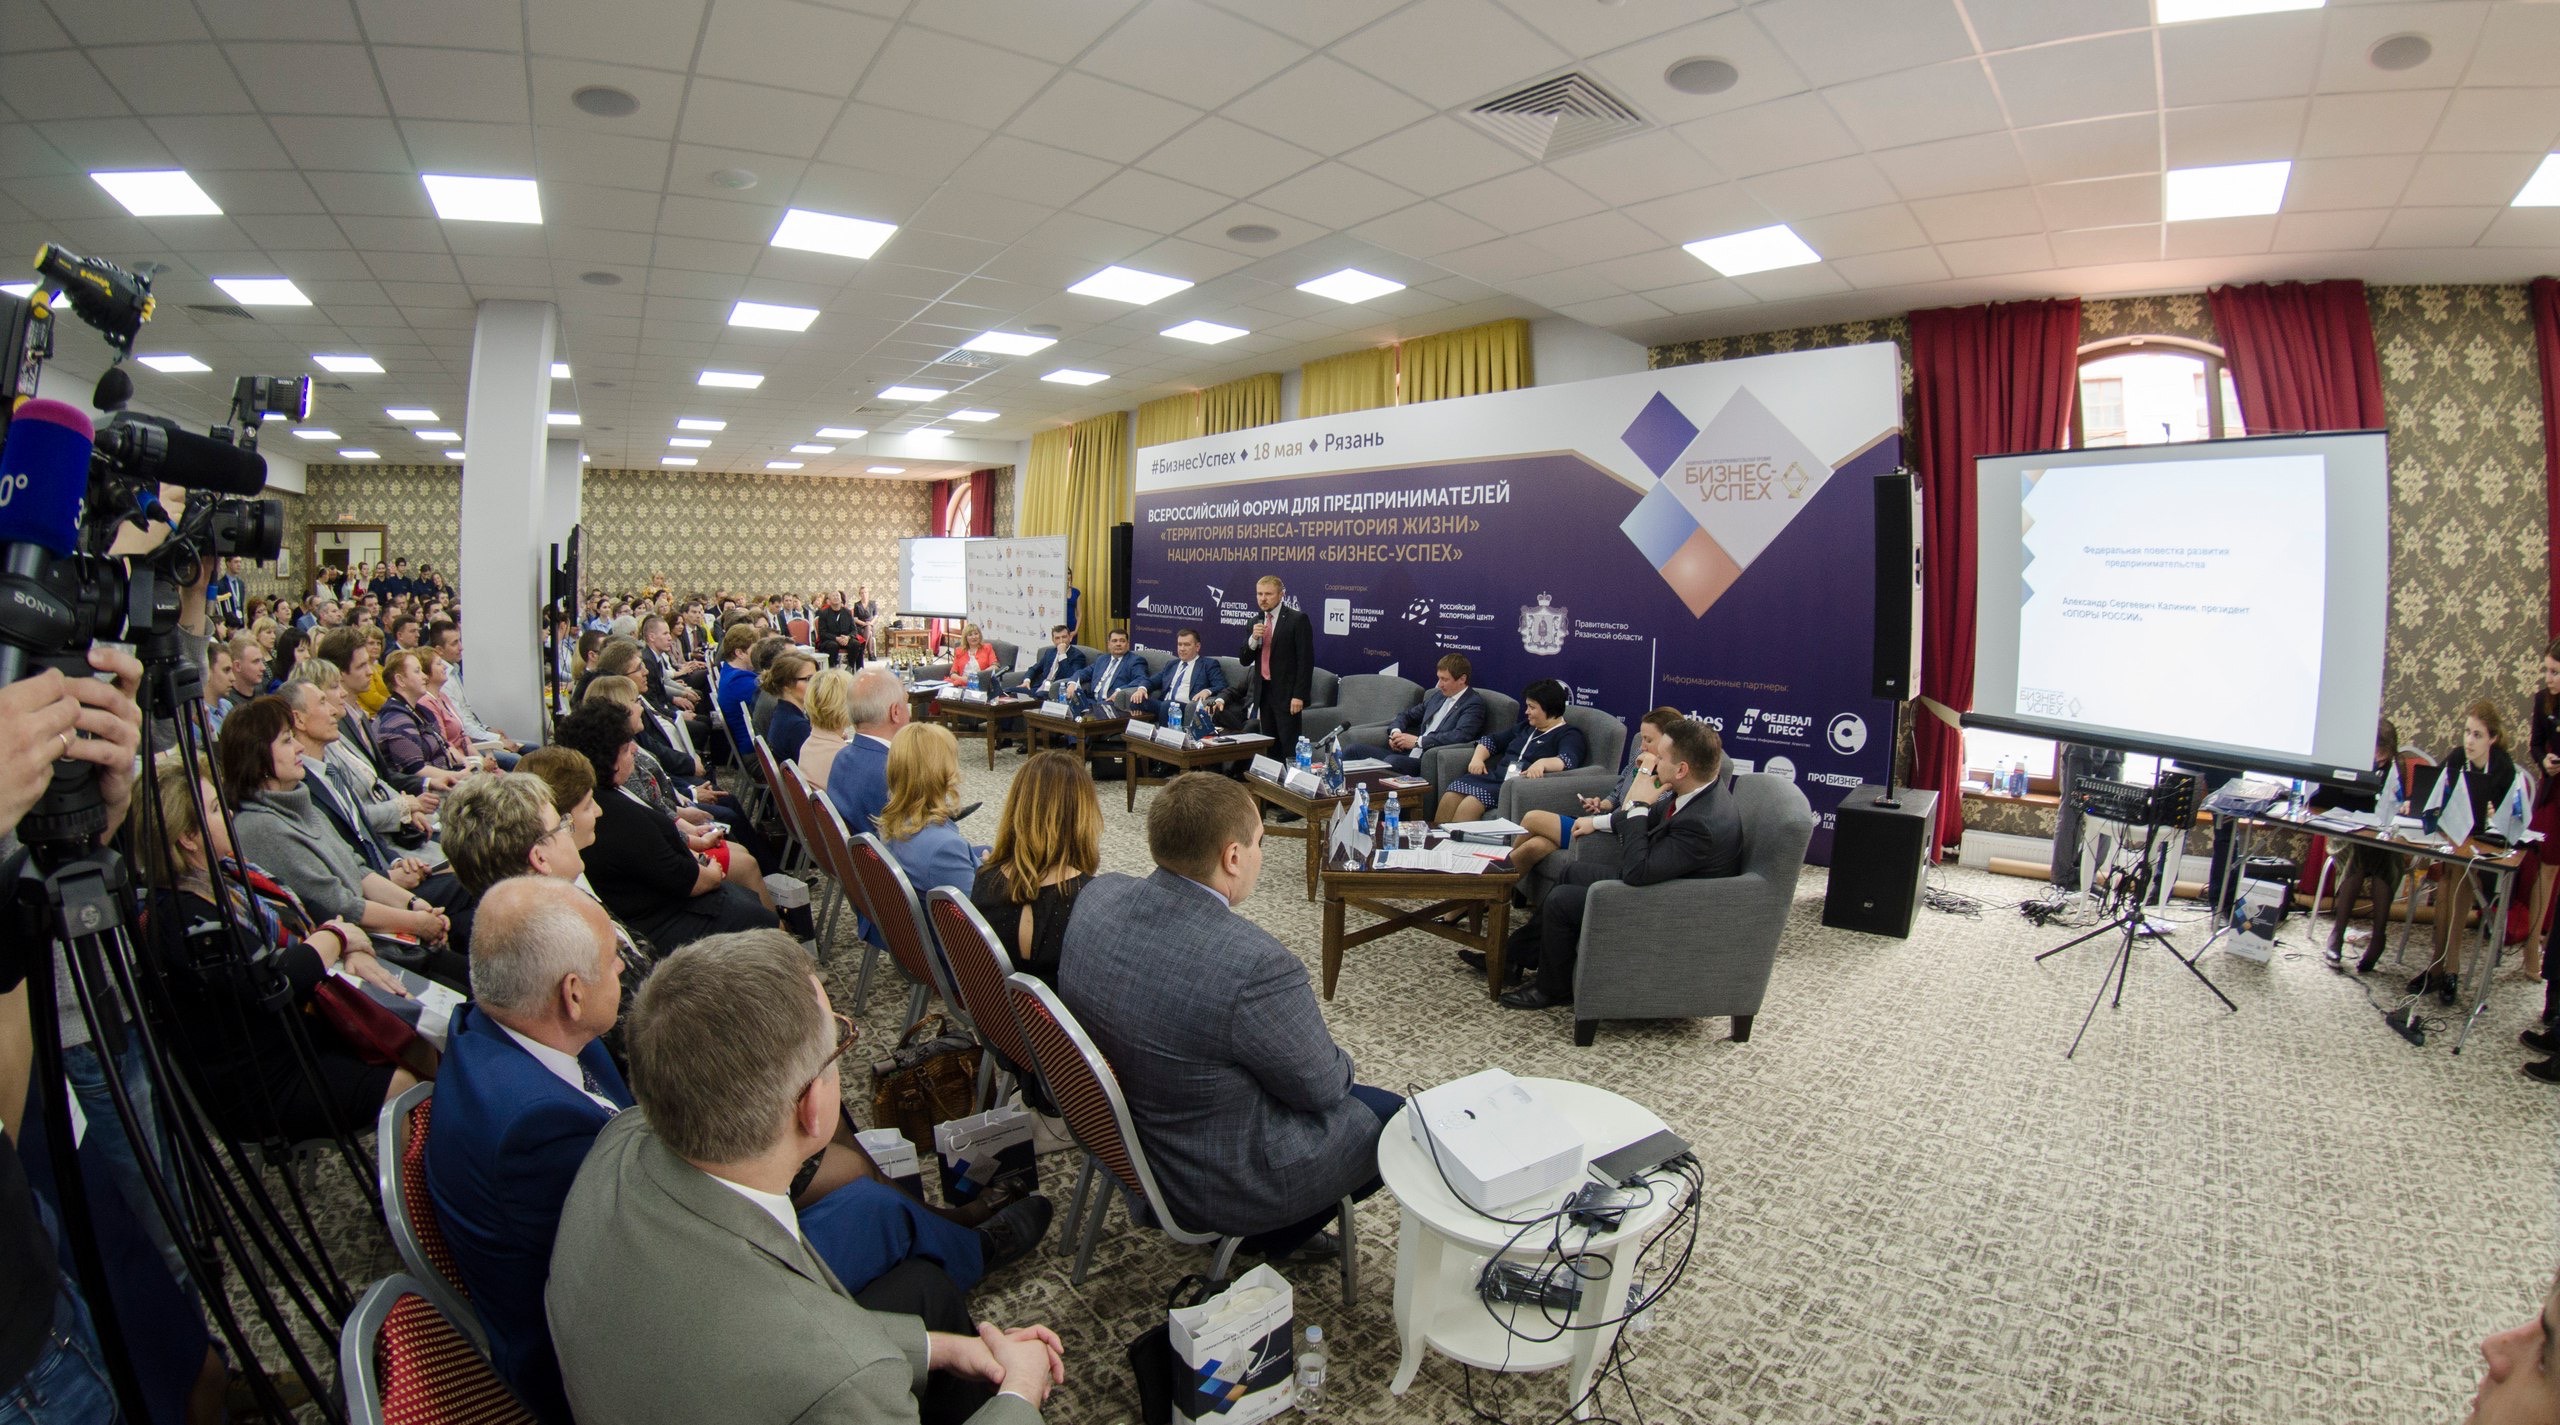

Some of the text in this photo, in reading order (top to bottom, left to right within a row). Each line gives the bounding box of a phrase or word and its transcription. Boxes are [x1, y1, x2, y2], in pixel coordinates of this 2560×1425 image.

[1151, 431, 1385, 475] #БизнесУспех 18 мая Рязань
[1685, 462, 1777, 485] БИЗНЕС-
[1700, 481, 1772, 502] УСПЕХ
[1148, 479, 1511, 523] ВСЕРОССИЙСКИЙ ФОРУМ ДЛЯ ПРЕДПРИНИМАТЕЛЕЙ
[1160, 515, 1480, 542] «ТЕРРИТОРИЯ БИЗНЕСА-ТЕРРИТОРИЯ ЖИЗНИ»
[1167, 543, 1463, 564] НАЦИОНАЛЬНАЯ ПРЕМИЯ «БИЗНЕС-УСПЕХ»
[2083, 546, 2229, 556] Федеральная повестка развития
[2105, 560, 2206, 569] предпринимательства
[14, 590, 57, 618] SONY
[1149, 603, 1172, 615] ОПОРА
[1174, 605, 1204, 617] РОССИИ
[1221, 601, 1248, 610] АГЕНТСТВО
[1439, 603, 1476, 611] РОССИЙСКИЙ
[2062, 597, 2107, 608] Александр
[2109, 599, 2155, 609] Сергеевич
[2201, 605, 2250, 615] президент
[1329, 612, 1345, 622] РТС
[1351, 615, 1378, 623] ПЛОЩАДКА
[1352, 608, 1385, 616] ЭЛЕКТРОННАЯ
[1439, 611, 1476, 620] ЭКСПОРТНЫЙ
[1575, 619, 1629, 631] Правительство
[1574, 630, 1643, 641] Рязанской области
[1662, 673, 1789, 693] Информационные партнеры:
[2027, 702, 2064, 716] УСПЕХ
[1761, 712, 1812, 727] ФЕДЕРАЛ
[1768, 724, 1804, 737] ПРЕСС
